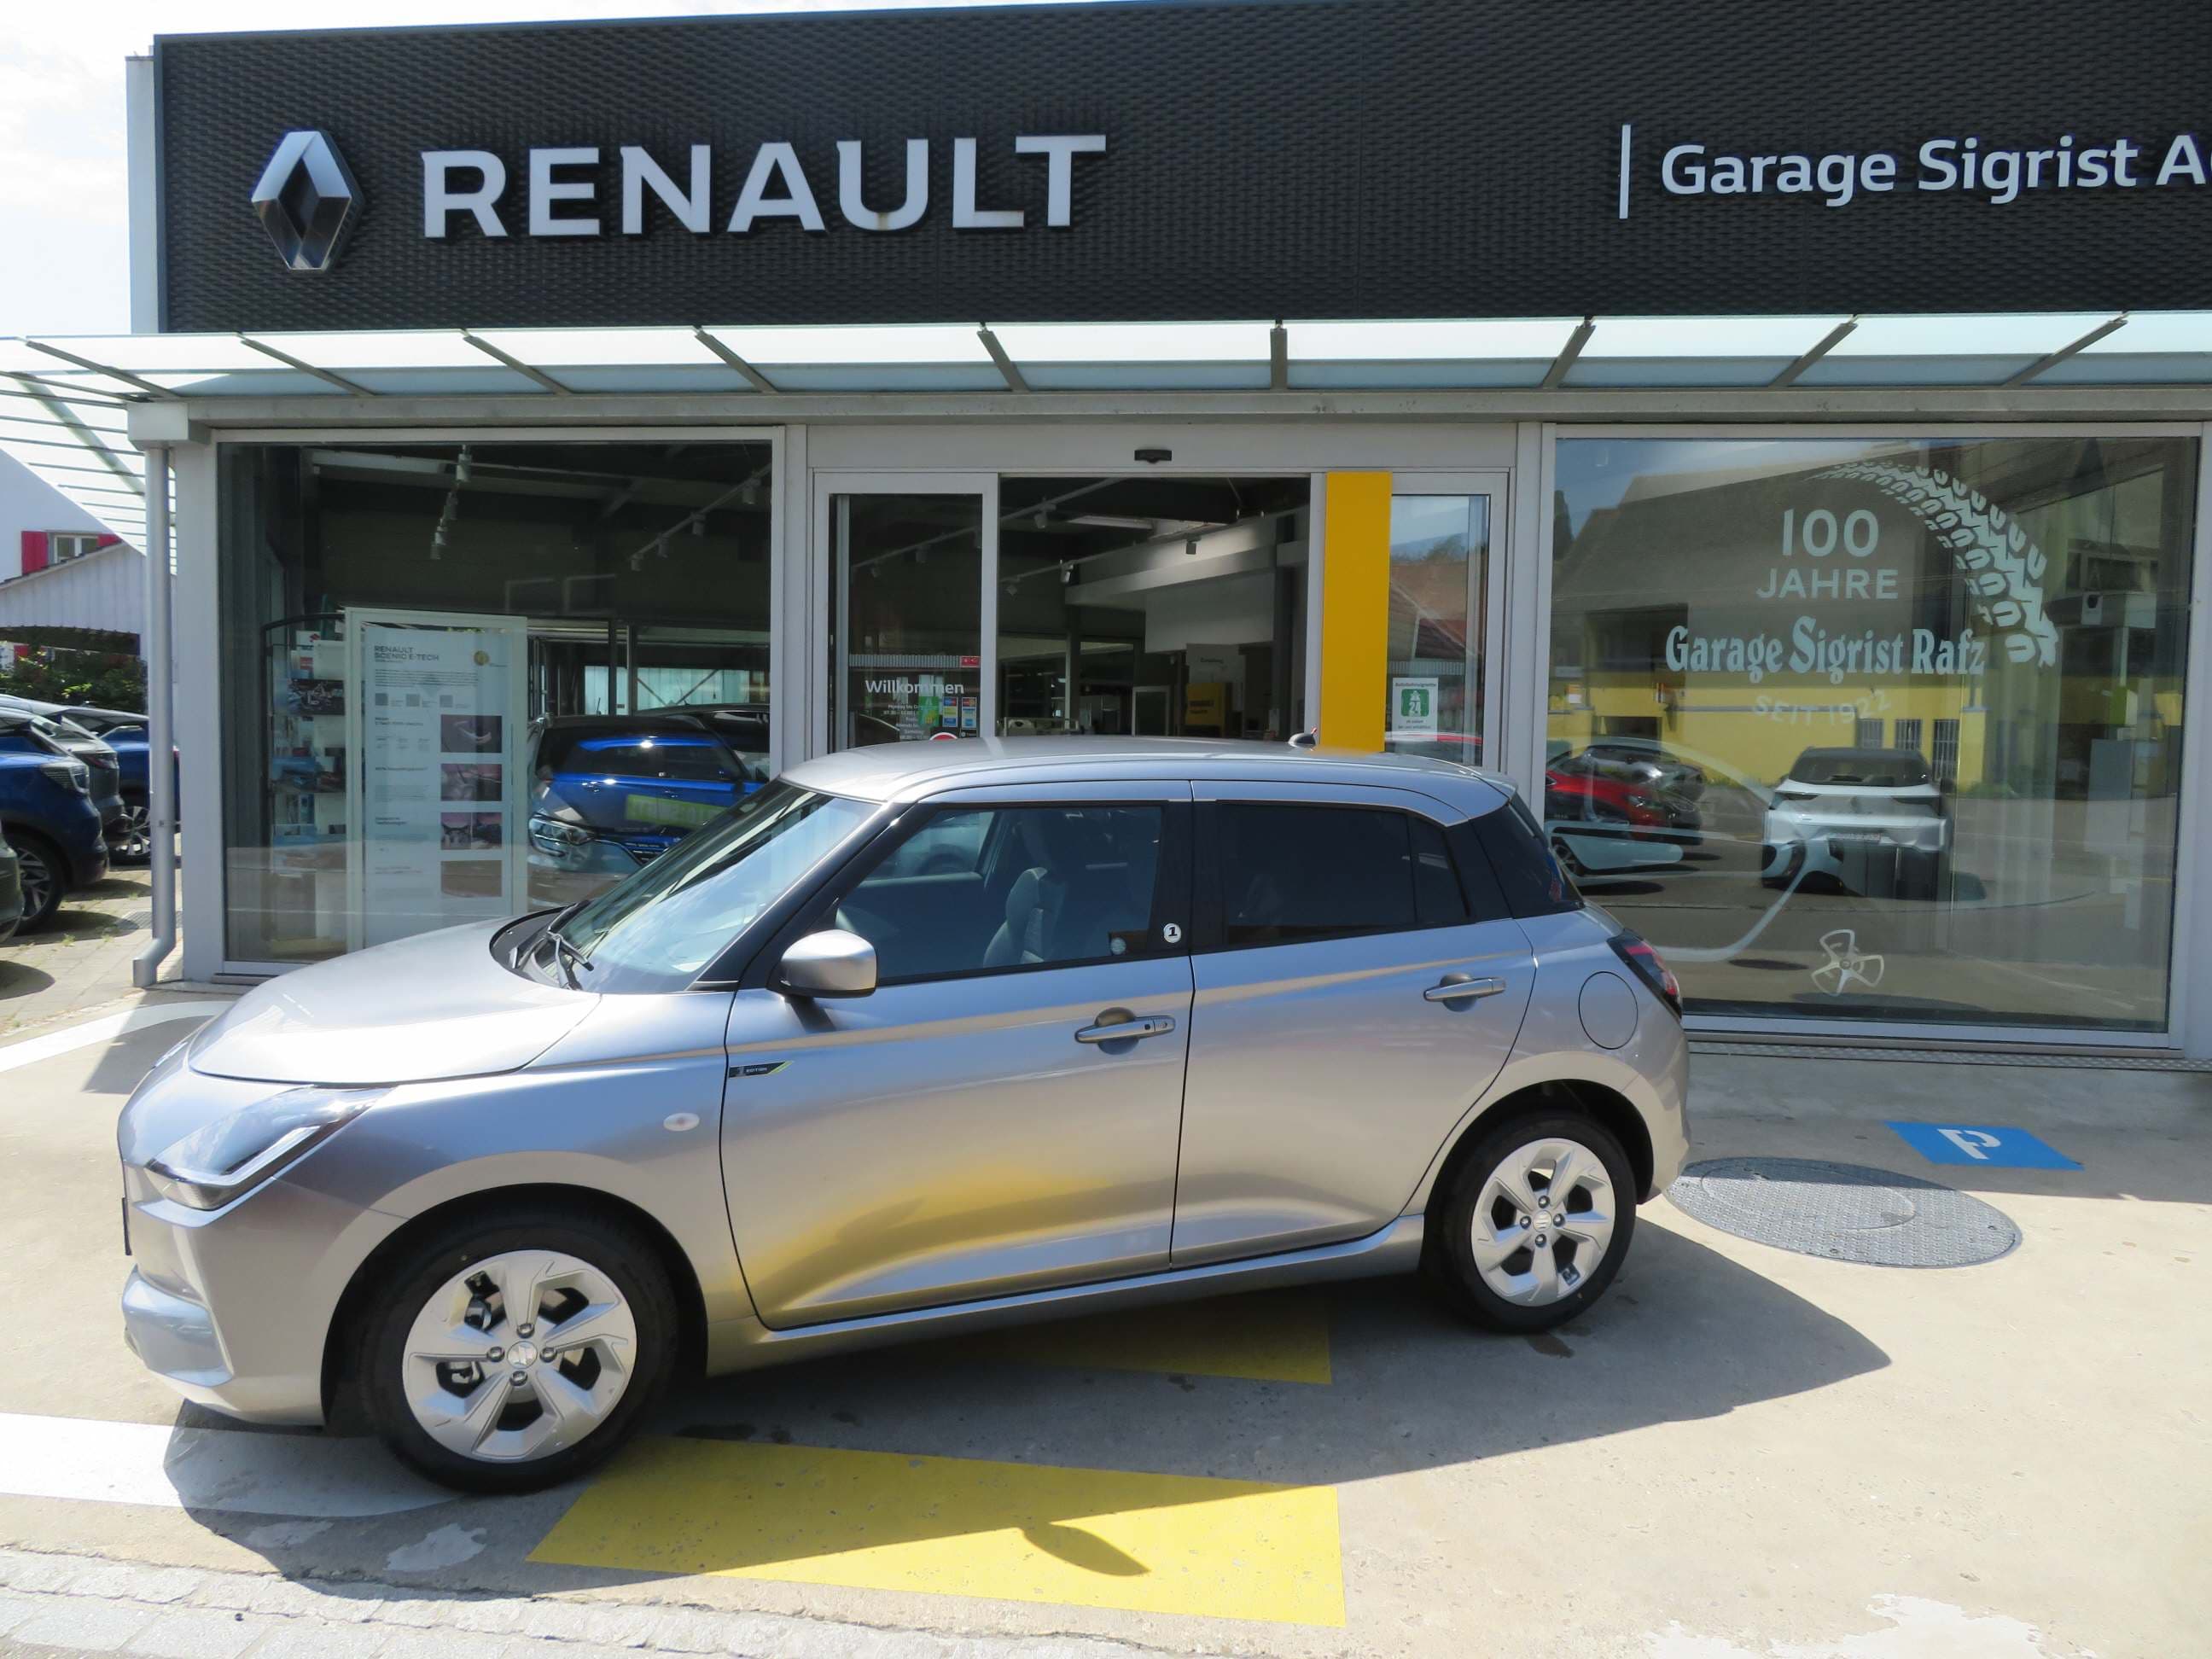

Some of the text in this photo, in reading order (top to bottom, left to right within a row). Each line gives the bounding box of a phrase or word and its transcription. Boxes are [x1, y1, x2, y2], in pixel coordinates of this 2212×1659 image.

[421, 134, 1107, 238] RENAULT
[1661, 134, 2212, 207] Garage Sigrist A
[1783, 509, 1878, 557] 100
[1755, 568, 1899, 599] JAHRE
[374, 645, 414, 654] RENAULT
[1665, 615, 1985, 684] Garage Sigrist Rafz
[1755, 689, 1891, 725] SEIT 1922
[1168, 926, 1178, 937] 1
[1936, 1128, 2001, 1160] P
